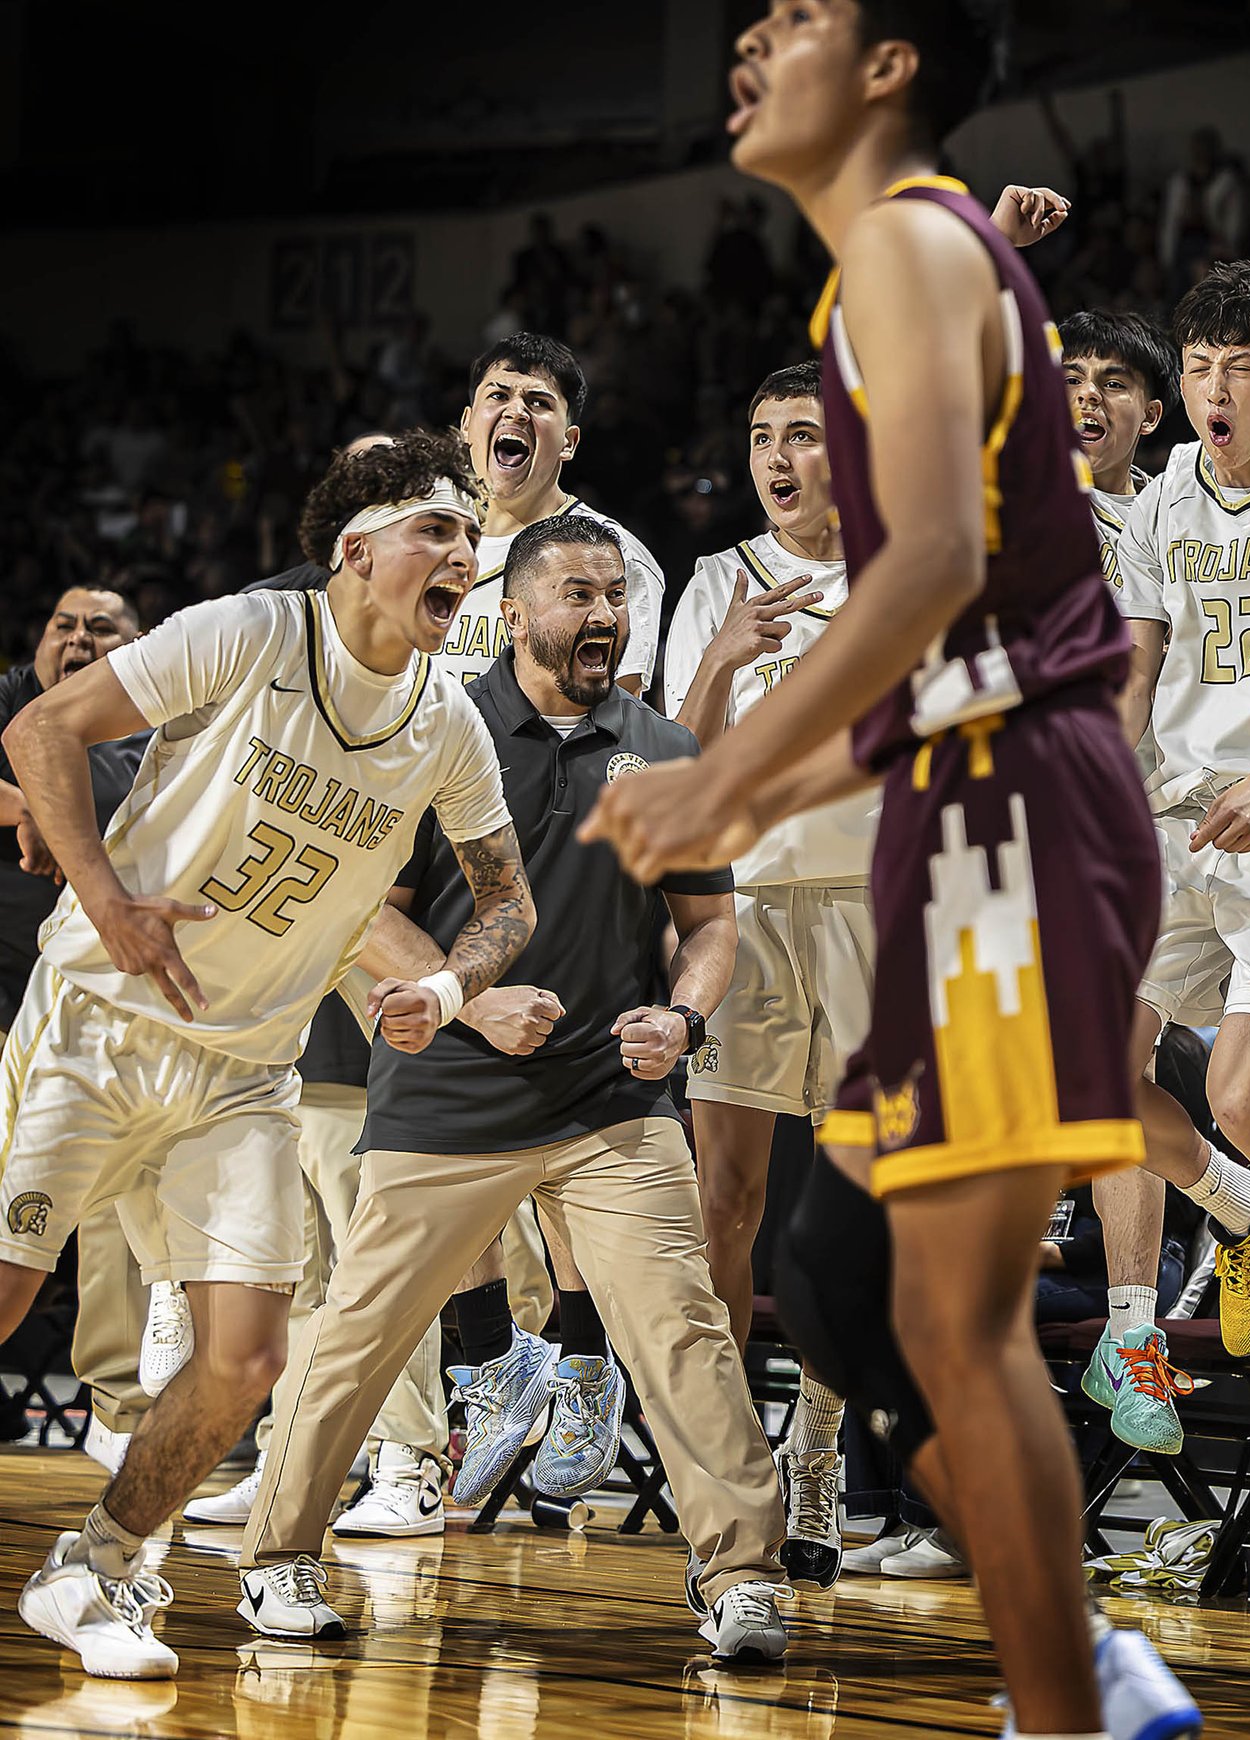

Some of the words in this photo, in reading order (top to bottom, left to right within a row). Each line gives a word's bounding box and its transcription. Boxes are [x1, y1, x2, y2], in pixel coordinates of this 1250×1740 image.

[279, 250, 411, 319] 212
[234, 736, 405, 850] TROJANS
[198, 820, 340, 938] 32
